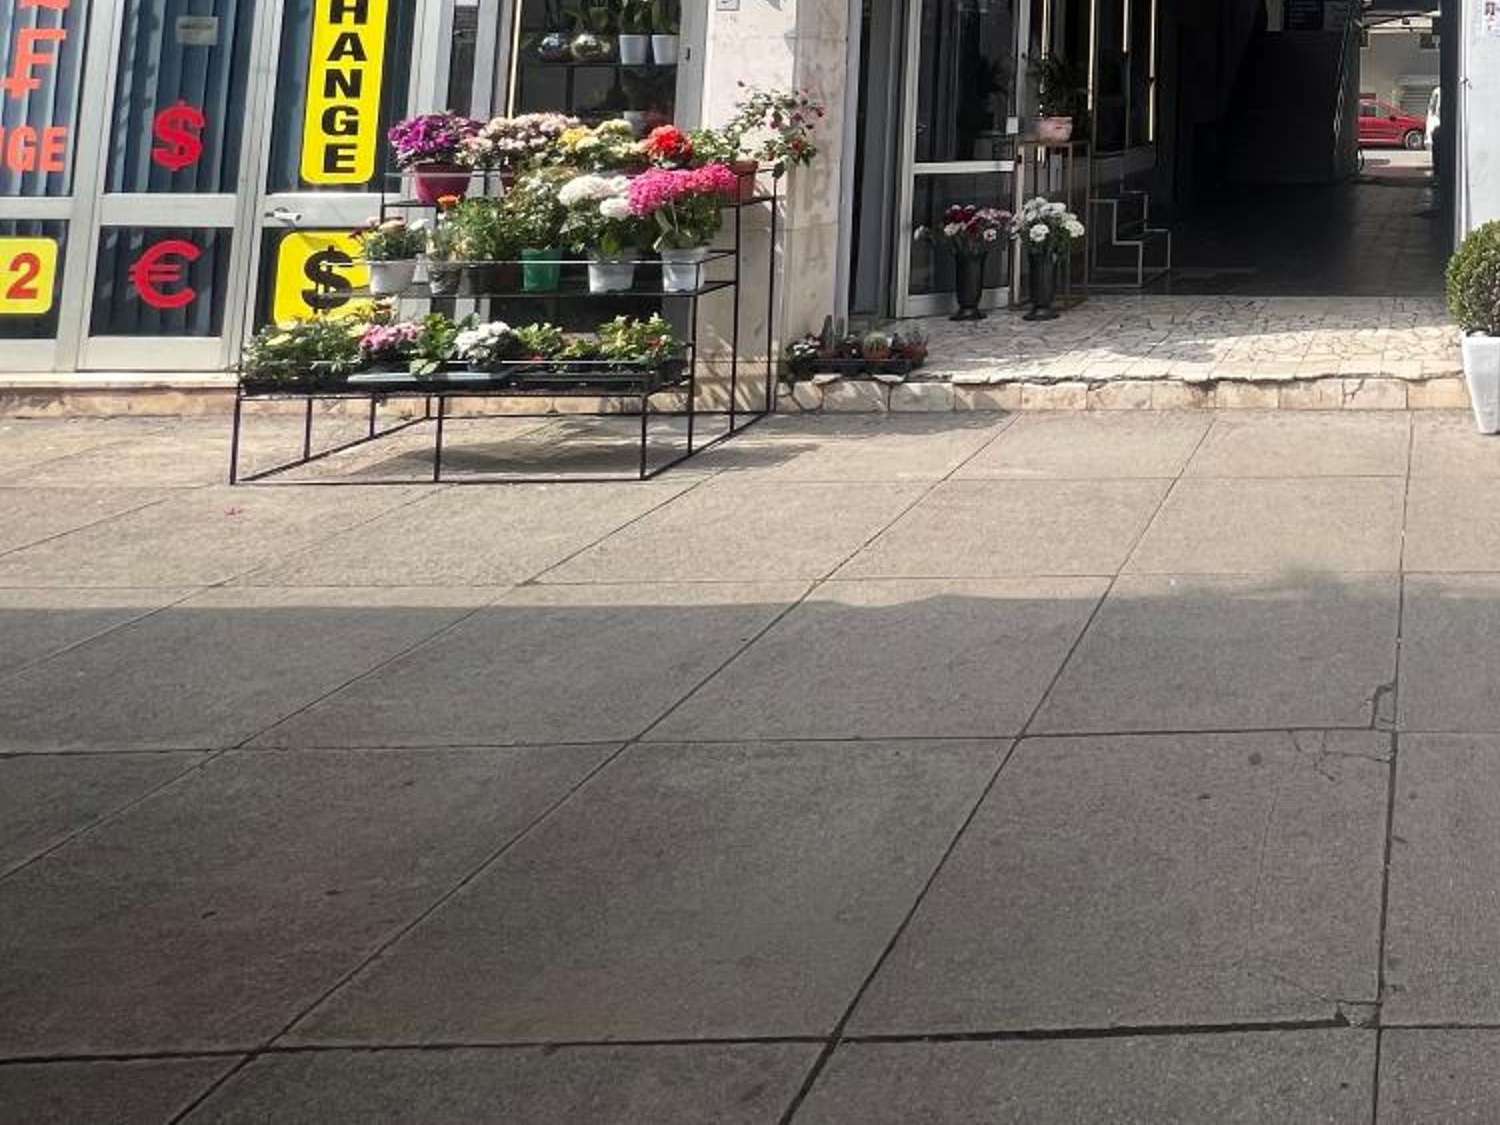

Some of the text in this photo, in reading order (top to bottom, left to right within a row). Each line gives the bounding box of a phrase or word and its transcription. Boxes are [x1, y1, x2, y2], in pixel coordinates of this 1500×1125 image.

[0, 126, 66, 173] GE
[152, 100, 206, 172] $
[301, 244, 353, 313] $
